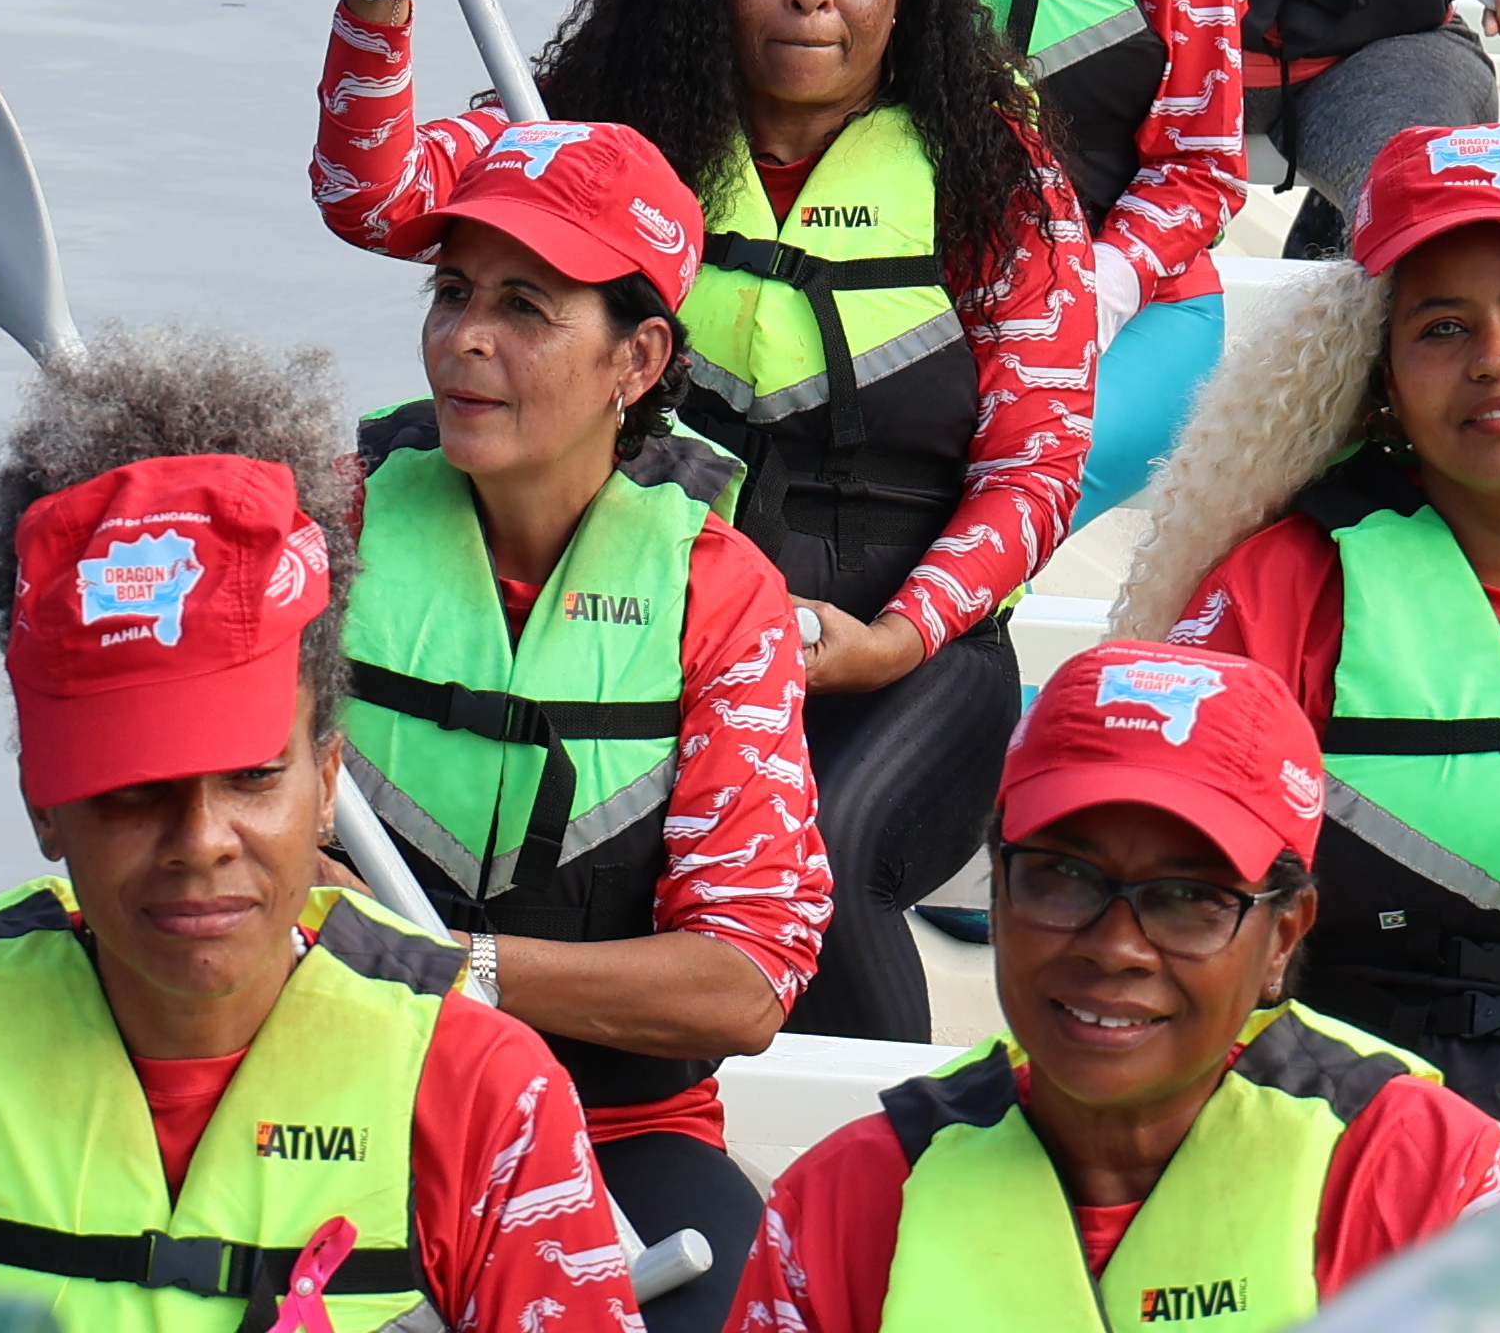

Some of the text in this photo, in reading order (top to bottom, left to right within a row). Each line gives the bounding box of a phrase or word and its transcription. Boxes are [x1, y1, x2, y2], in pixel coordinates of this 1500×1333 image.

[1458, 145, 1489, 155] BOAT
[484, 159, 523, 171] BAHIA
[142, 511, 212, 525] CANOAGEM
[104, 566, 166, 584] DRAGON
[116, 584, 155, 601] BOAT
[101, 625, 153, 647] BAHIA
[1125, 669, 1187, 685] DRAGON
[1132, 679, 1172, 692] BOAT
[1104, 715, 1160, 731] BAHIA
